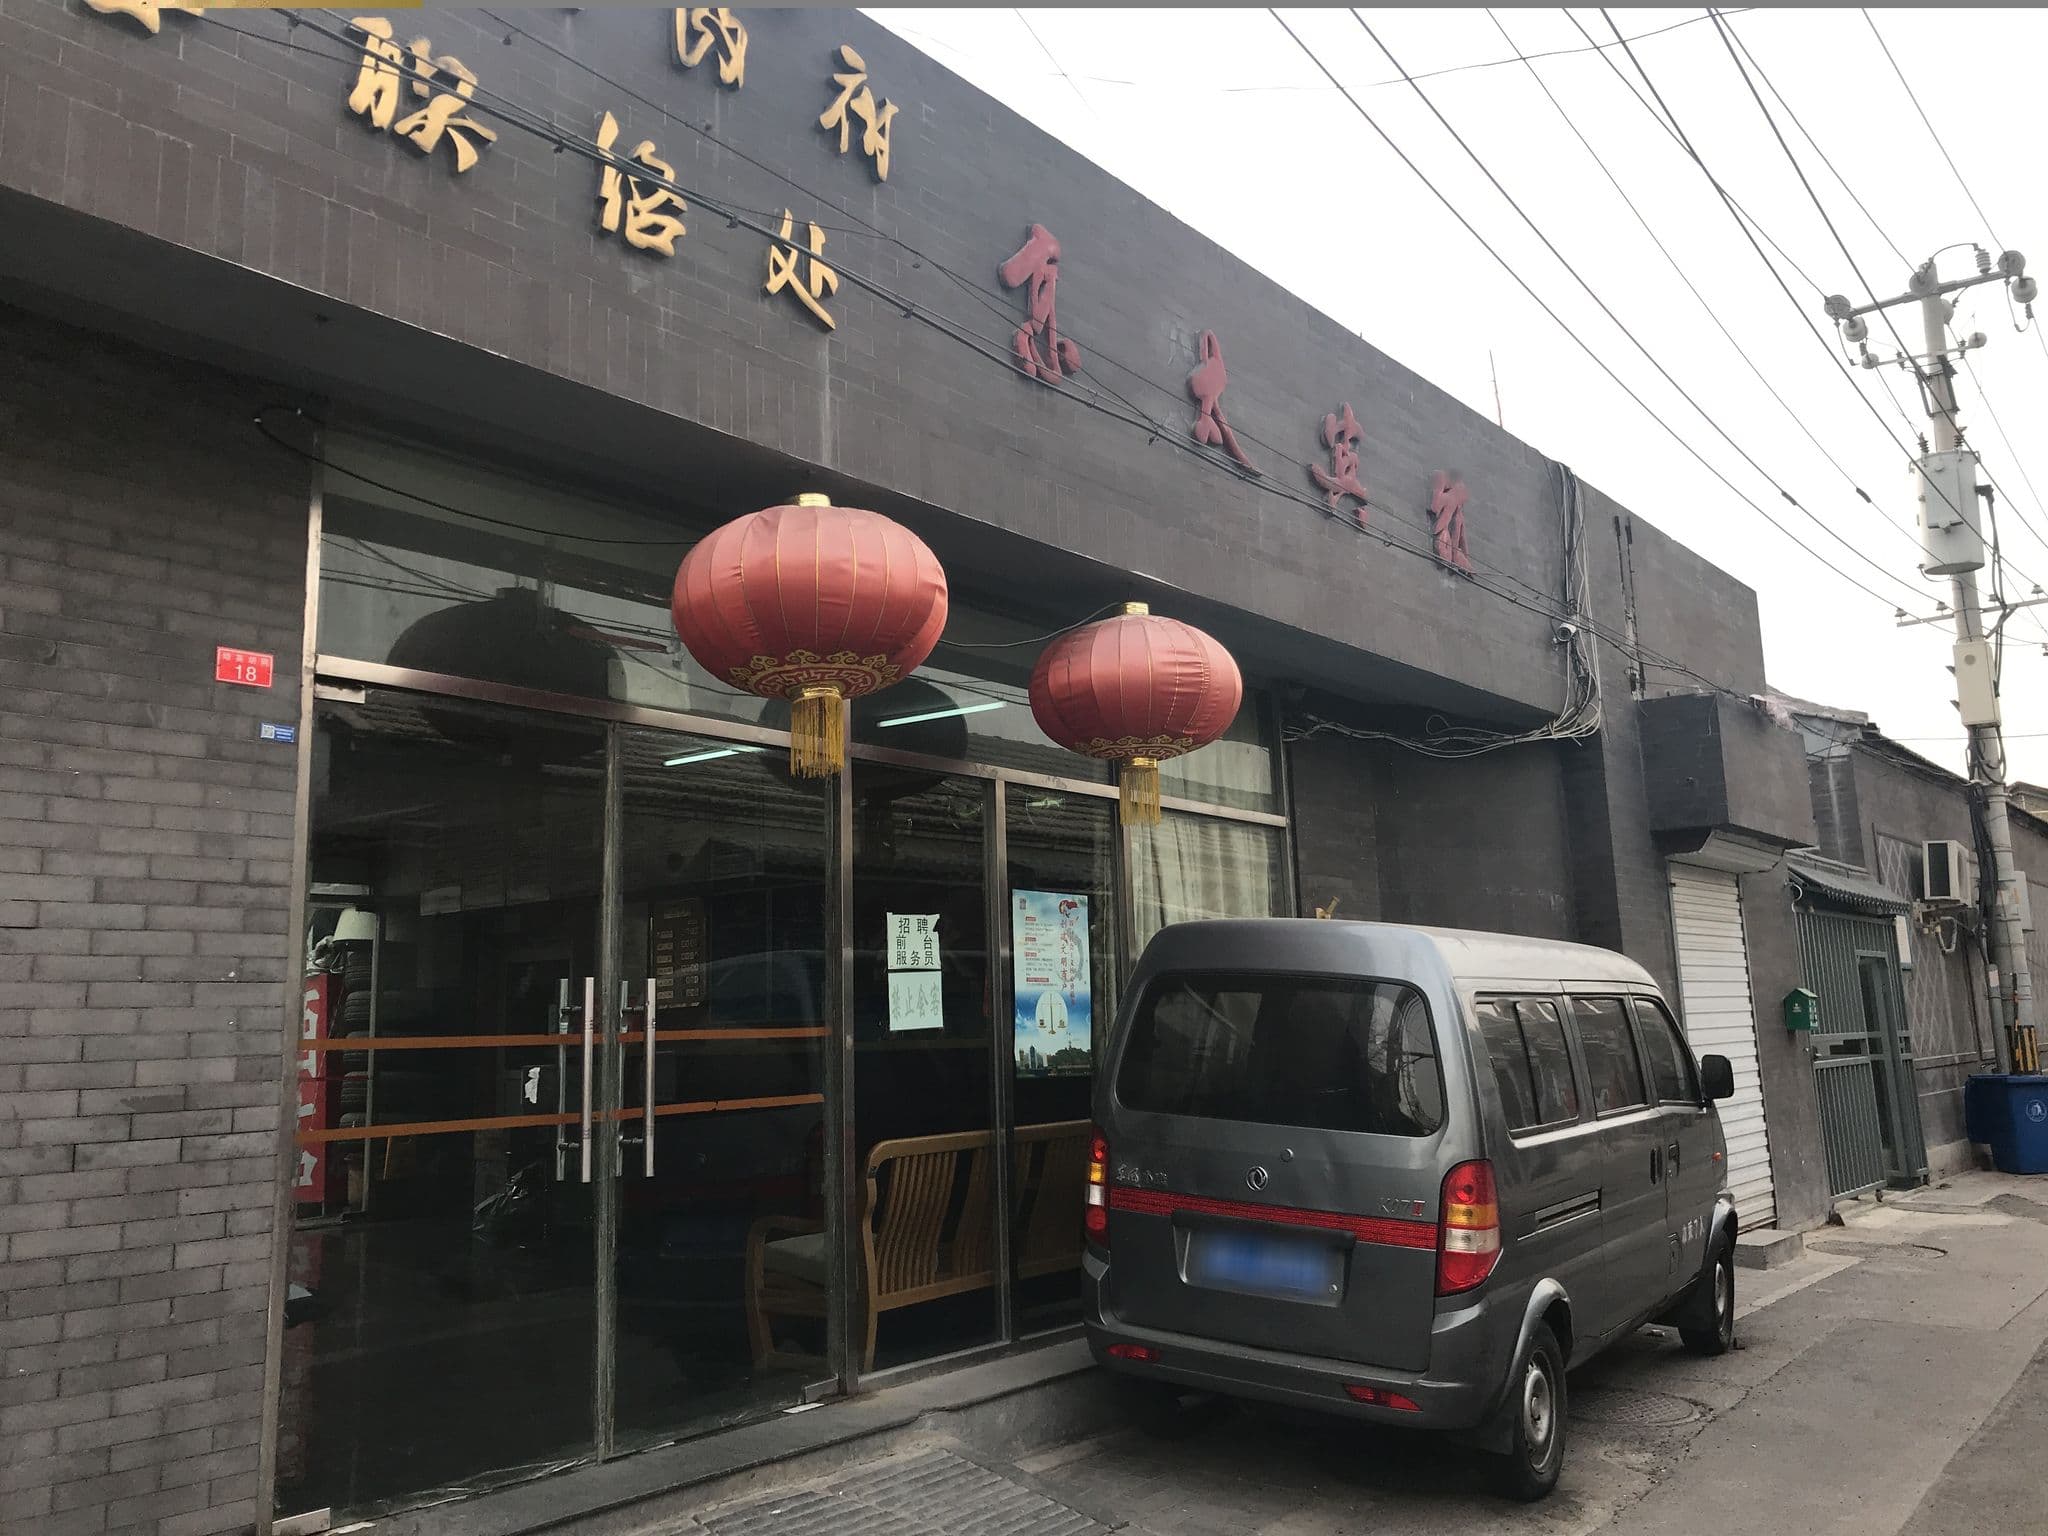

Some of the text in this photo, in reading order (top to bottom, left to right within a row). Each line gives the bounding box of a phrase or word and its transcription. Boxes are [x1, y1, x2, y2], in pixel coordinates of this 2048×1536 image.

[84, 8, 839, 330] 联络处
[235, 665, 257, 682] 18
[898, 917, 929, 935] 招聘
[896, 935, 933, 951] 前台
[896, 950, 934, 966] 服务员
